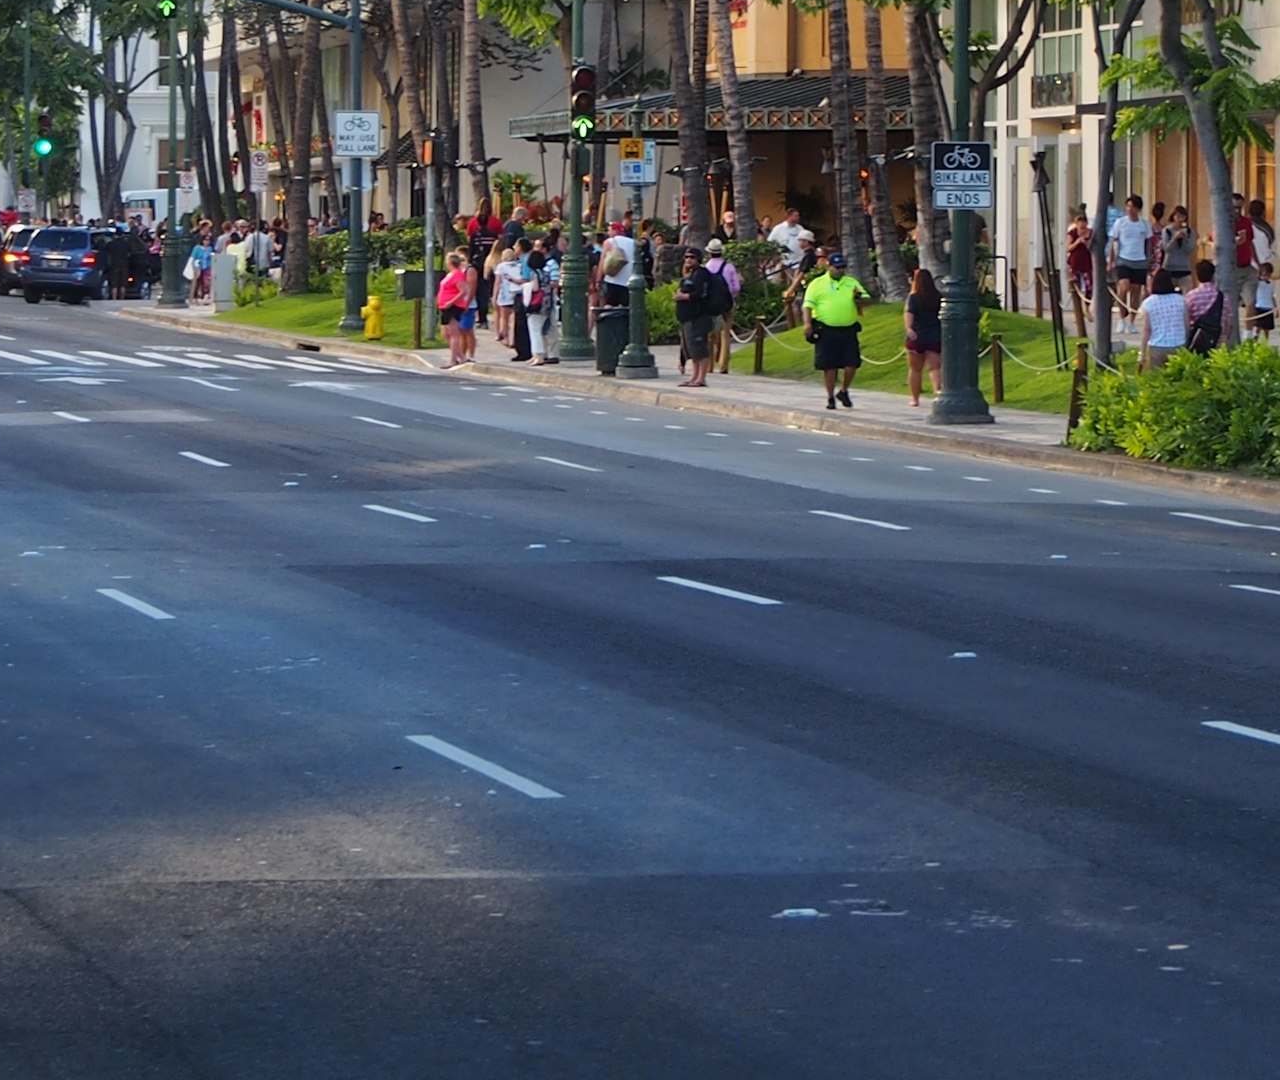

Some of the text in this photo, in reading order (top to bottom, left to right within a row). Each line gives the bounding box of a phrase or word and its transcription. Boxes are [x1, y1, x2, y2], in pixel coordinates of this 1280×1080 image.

[357, 144, 377, 152] LANE
[935, 172, 989, 183] BIKE LANE
[947, 193, 980, 205] ENDS
